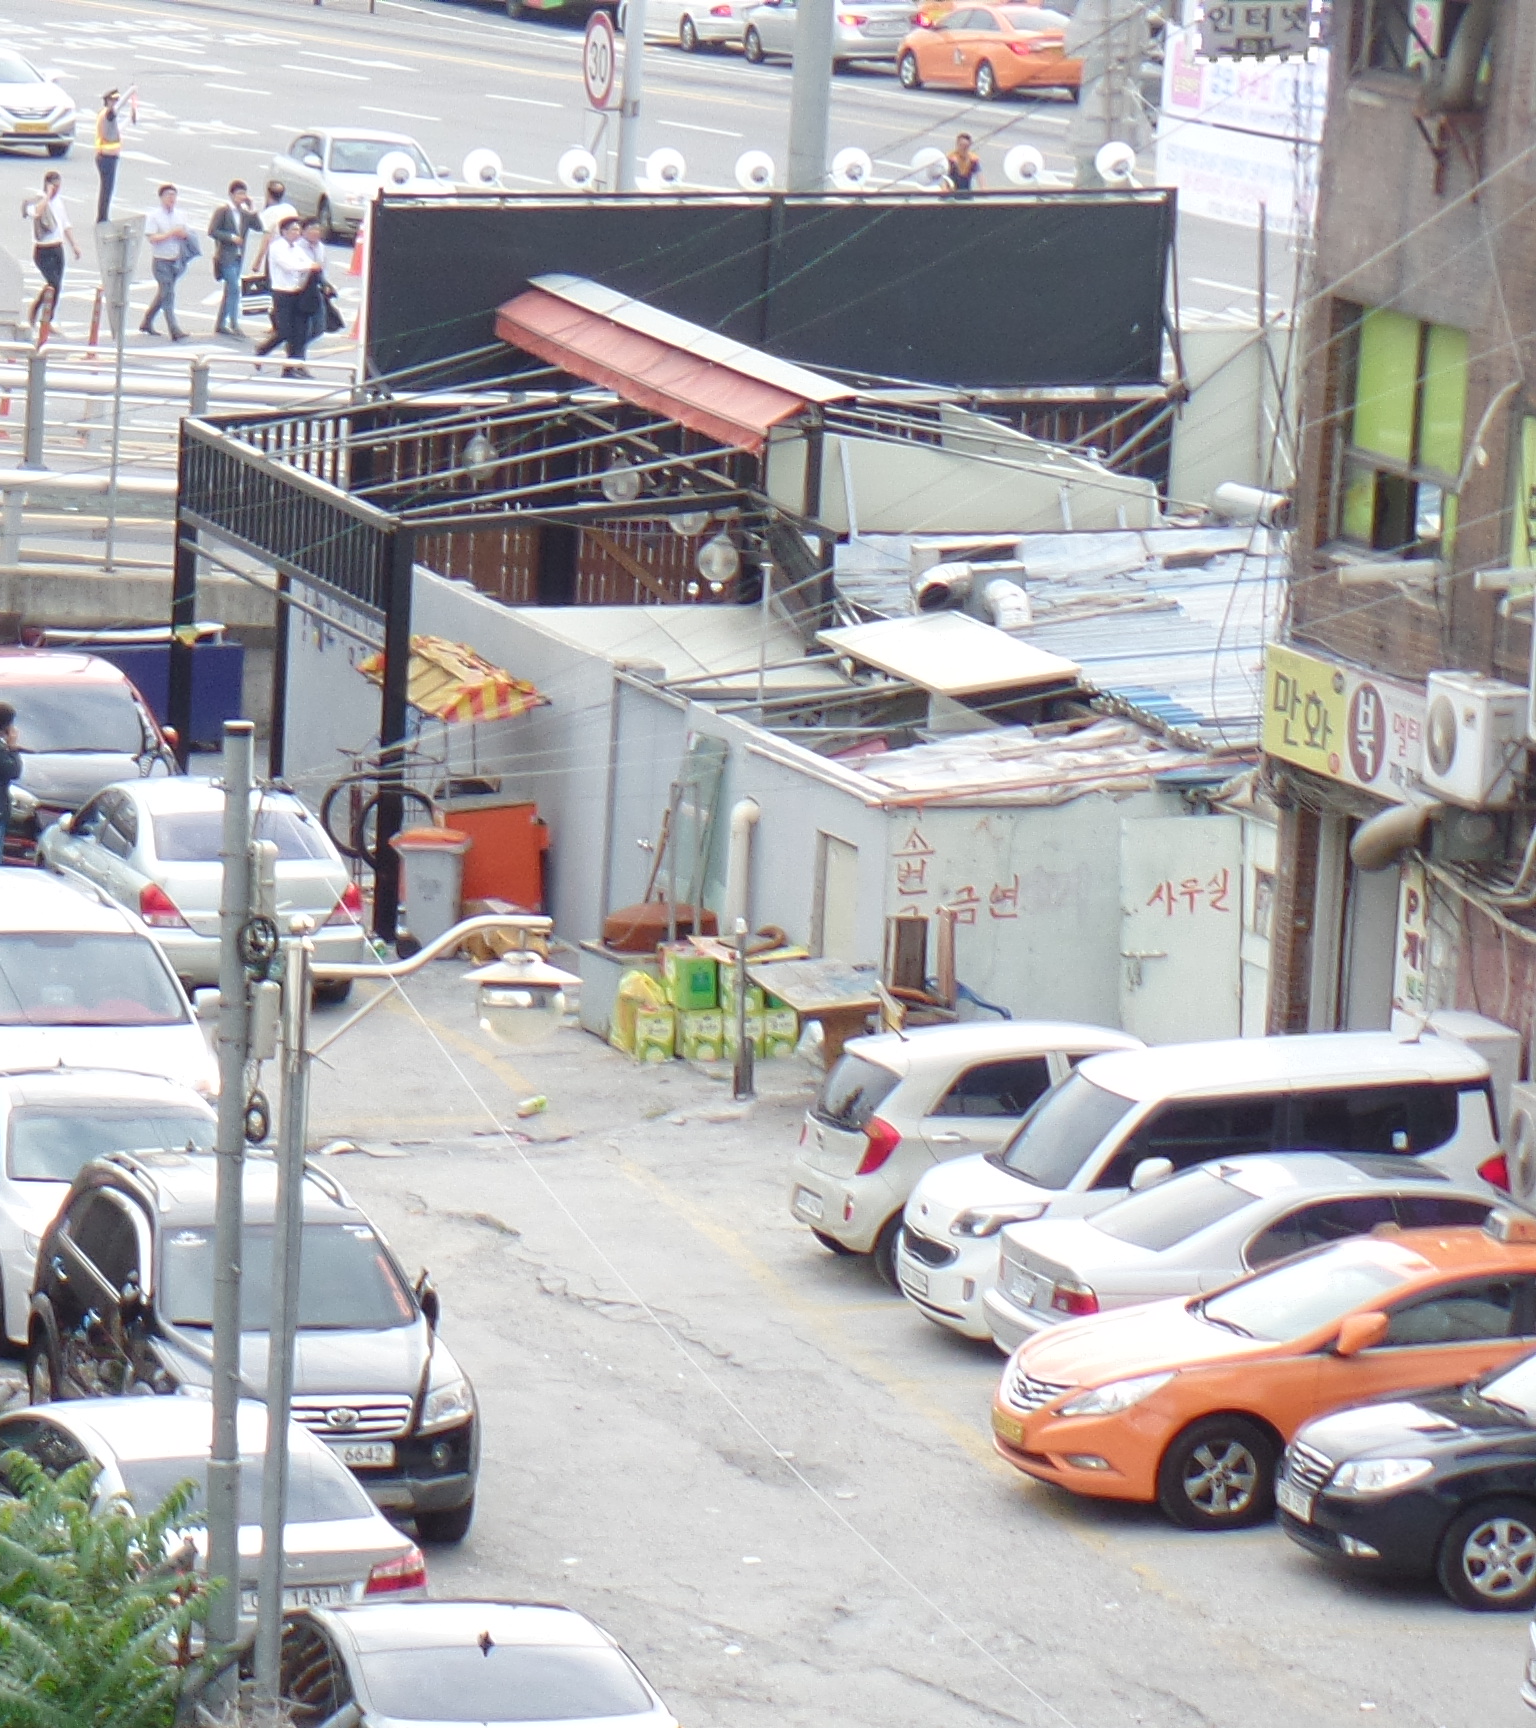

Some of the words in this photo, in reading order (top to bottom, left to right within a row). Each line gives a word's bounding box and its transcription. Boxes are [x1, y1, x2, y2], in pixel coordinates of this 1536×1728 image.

[1209, 6, 1306, 33] 인터넷
[589, 40, 609, 84] 30
[1273, 670, 1333, 752] 만화
[948, 873, 1021, 925] 금연
